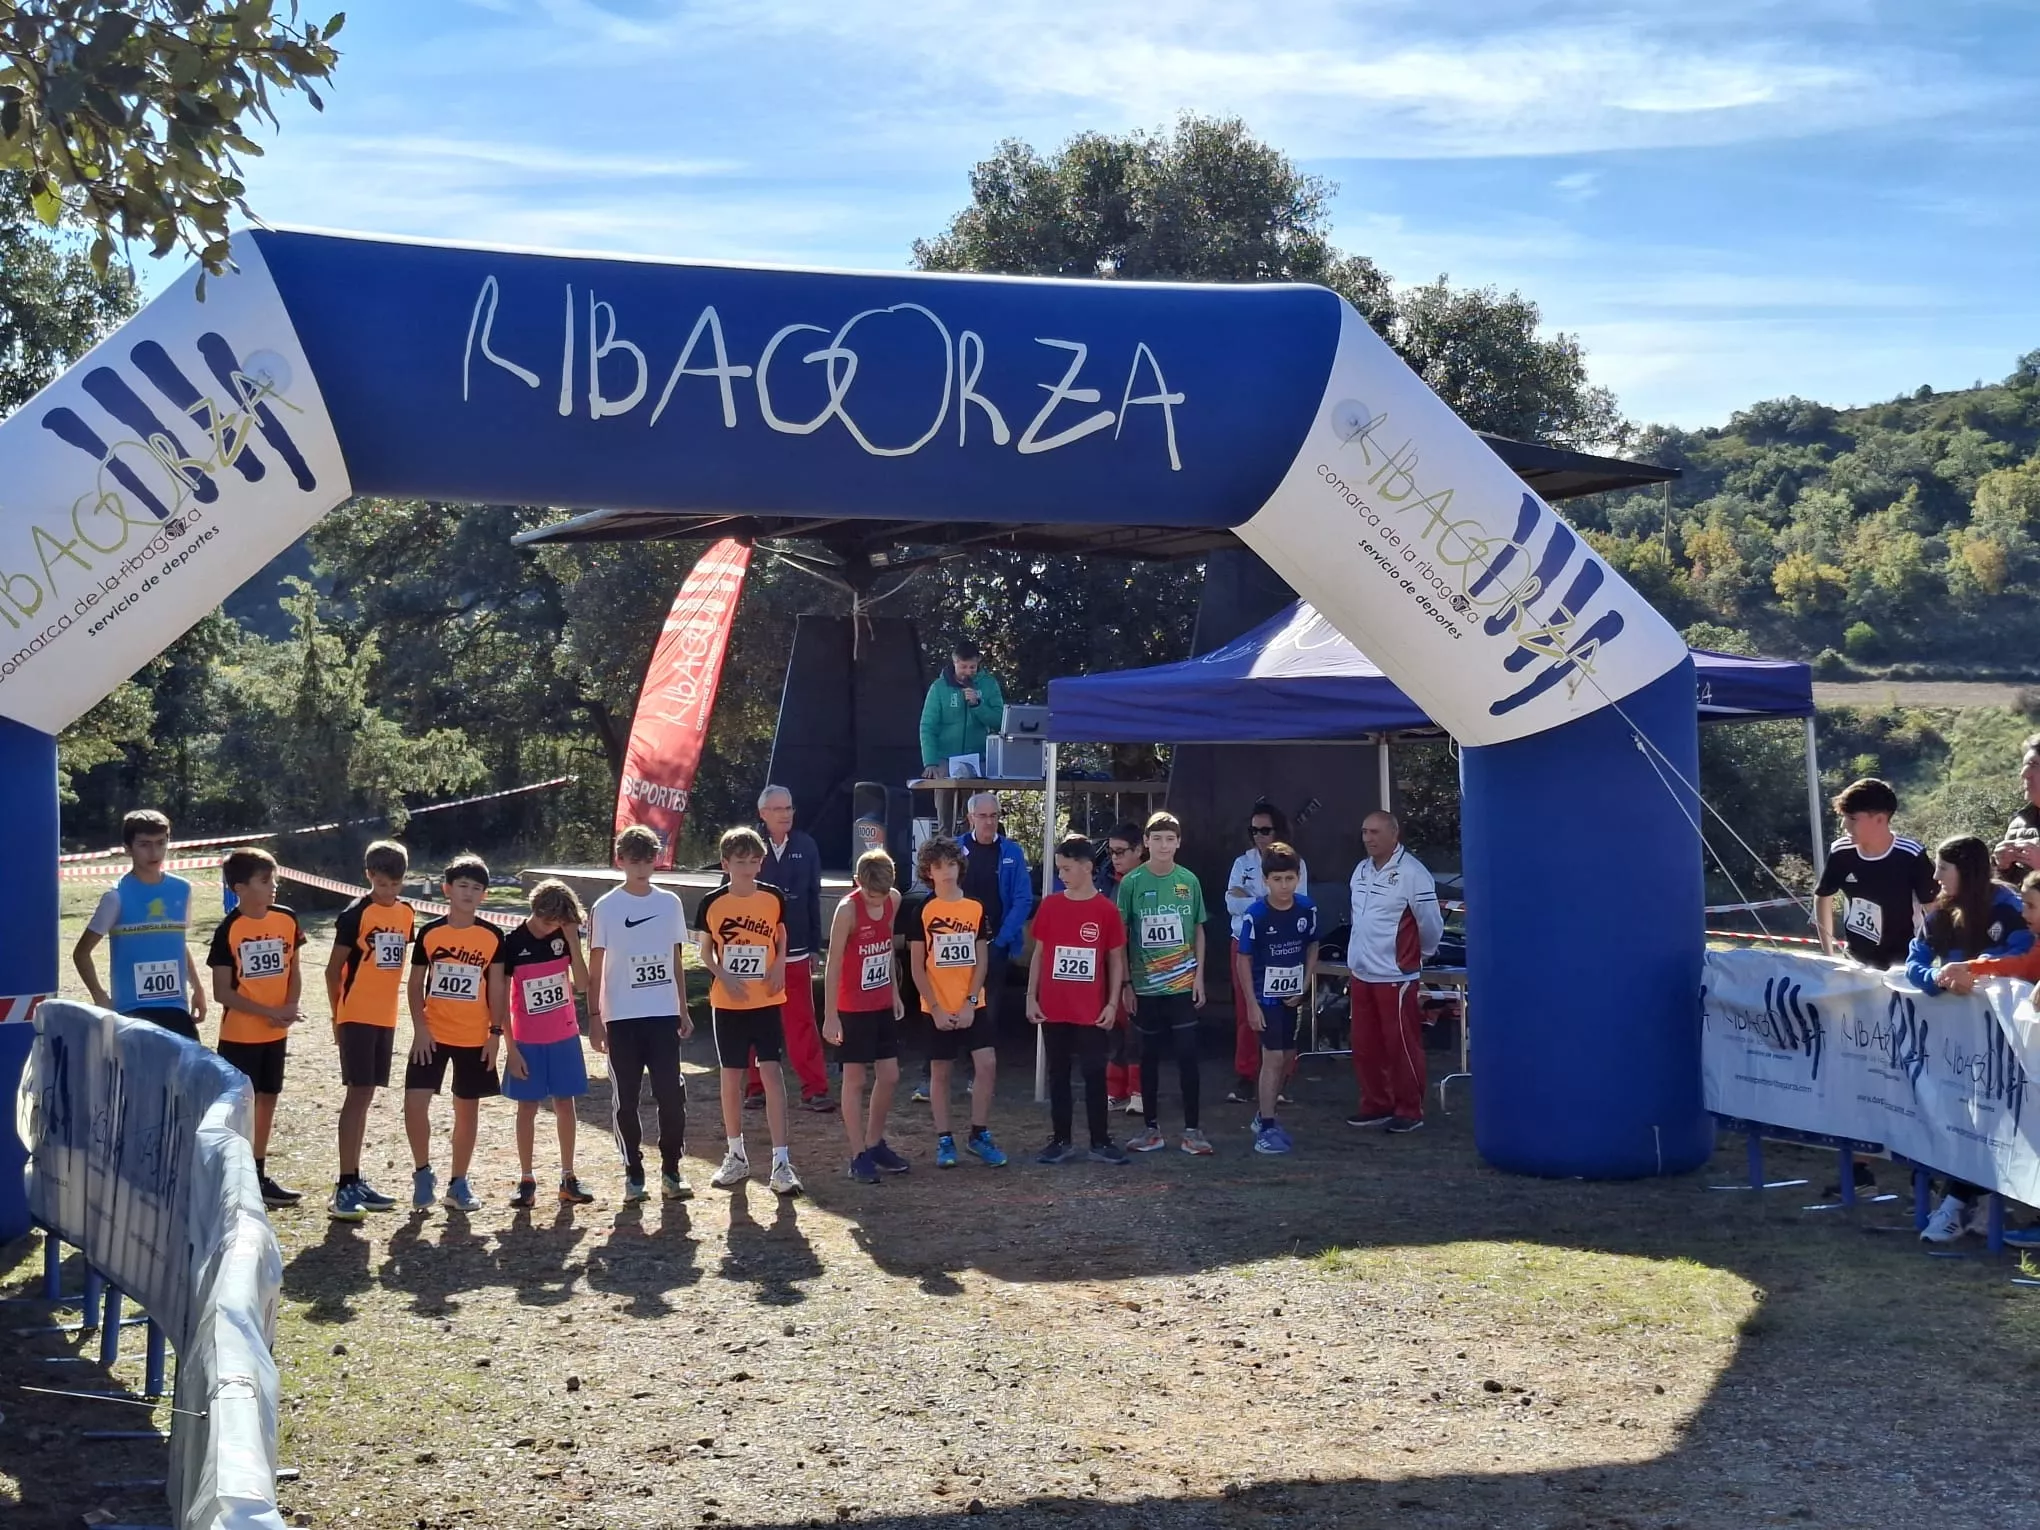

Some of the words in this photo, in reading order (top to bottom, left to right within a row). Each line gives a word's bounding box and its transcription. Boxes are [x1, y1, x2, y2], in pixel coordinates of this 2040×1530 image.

[464, 275, 1186, 472] RIBAGORZA
[1317, 464, 1381, 527] comarca
[1379, 526, 1401, 547] de
[1400, 543, 1417, 563] la
[1415, 561, 1480, 624] ribagorza
[1339, 412, 1597, 699] RIBAGORZA
[88, 592, 140, 637] servicio
[141, 574, 161, 593] de
[161, 525, 220, 576] deportes
[1358, 539, 1400, 580] servicio
[1399, 579, 1416, 596] de
[1415, 594, 1463, 640] deportes
[74, 592, 101, 617] de
[97, 574, 121, 594] la
[622, 774, 688, 813] DEPORTES
[1856, 911, 1880, 936] 39
[1148, 926, 1175, 942] 401
[250, 952, 280, 972] 399
[941, 945, 970, 960] 430
[636, 964, 666, 982] 335
[729, 958, 760, 973] 427
[1059, 959, 1089, 975] 326
[143, 974, 175, 993] 400
[438, 977, 472, 994] 402
[1270, 977, 1298, 991] 404
[532, 986, 564, 1007] 338
